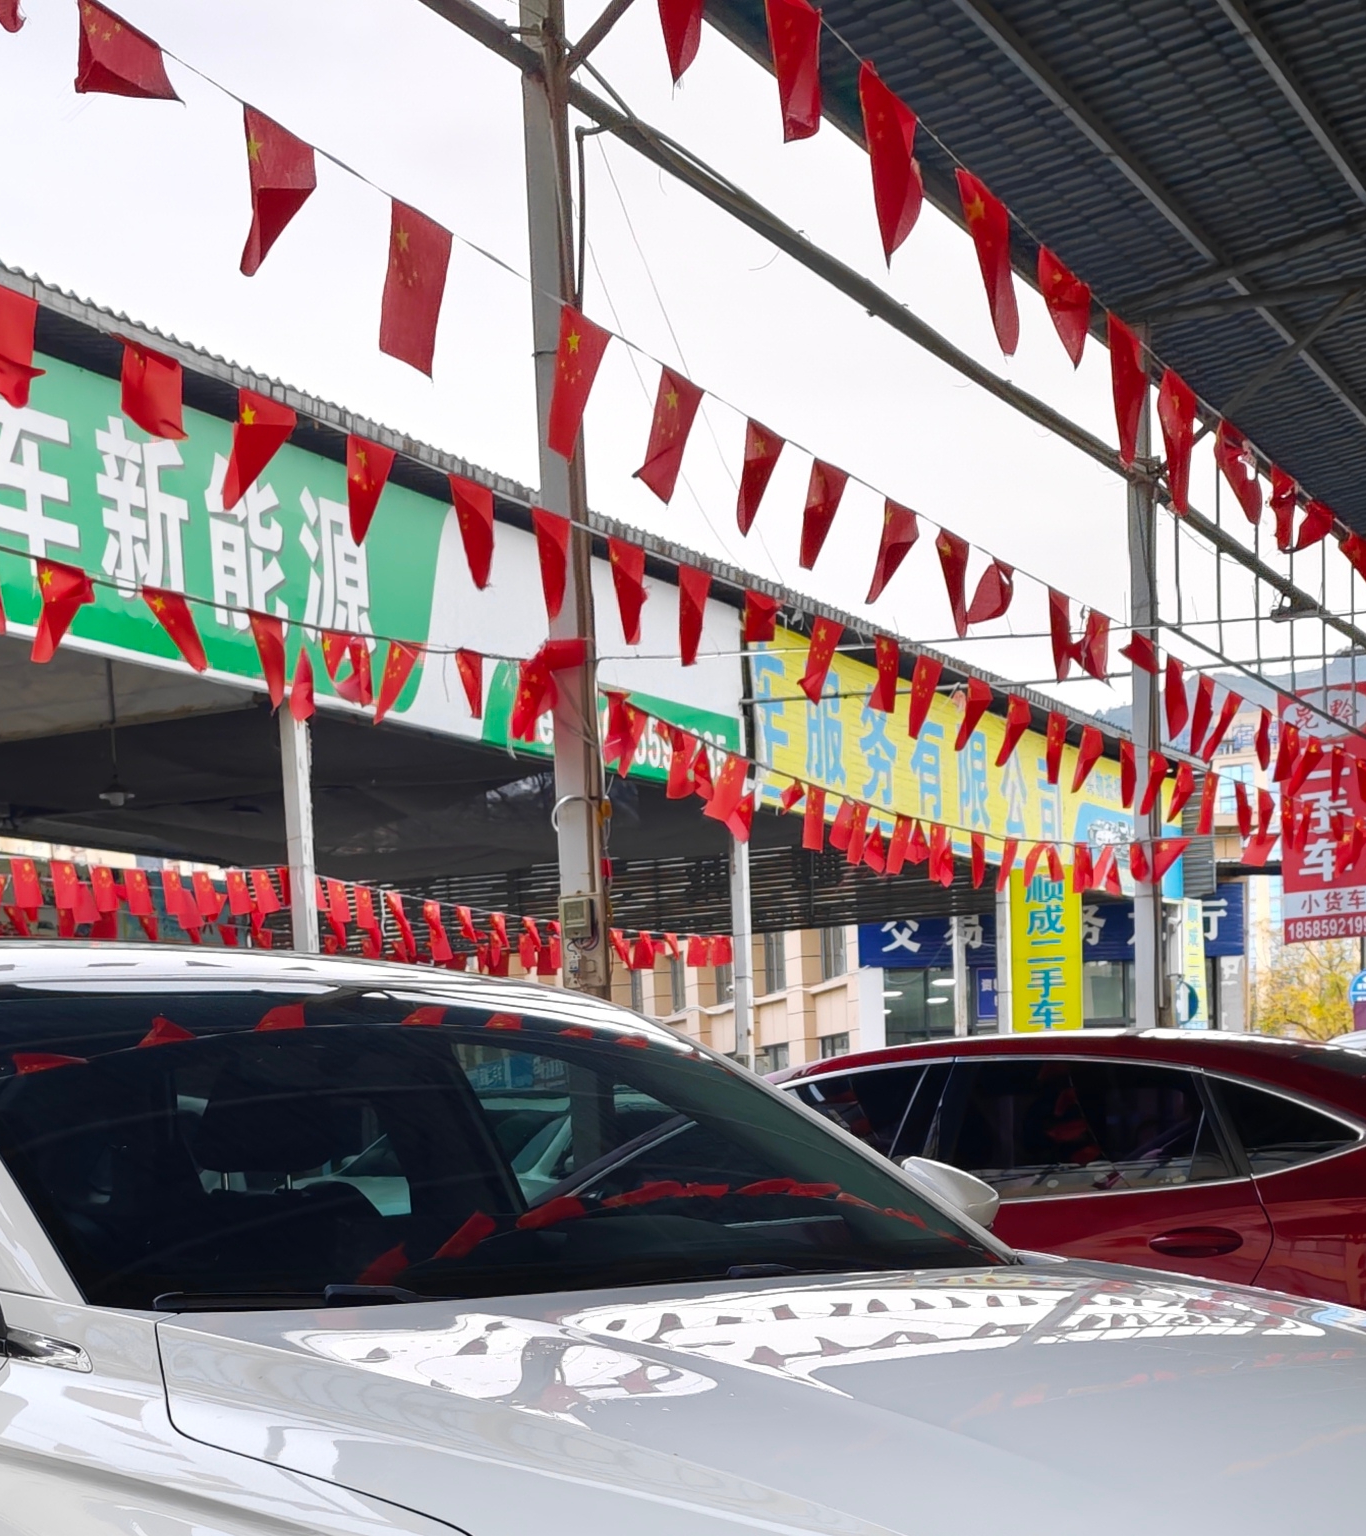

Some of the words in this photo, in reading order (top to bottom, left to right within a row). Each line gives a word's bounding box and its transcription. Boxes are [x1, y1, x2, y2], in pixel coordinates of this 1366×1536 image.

[1301, 889, 1366, 914] 小货车
[1026, 873, 1067, 1030] 顺成二手车
